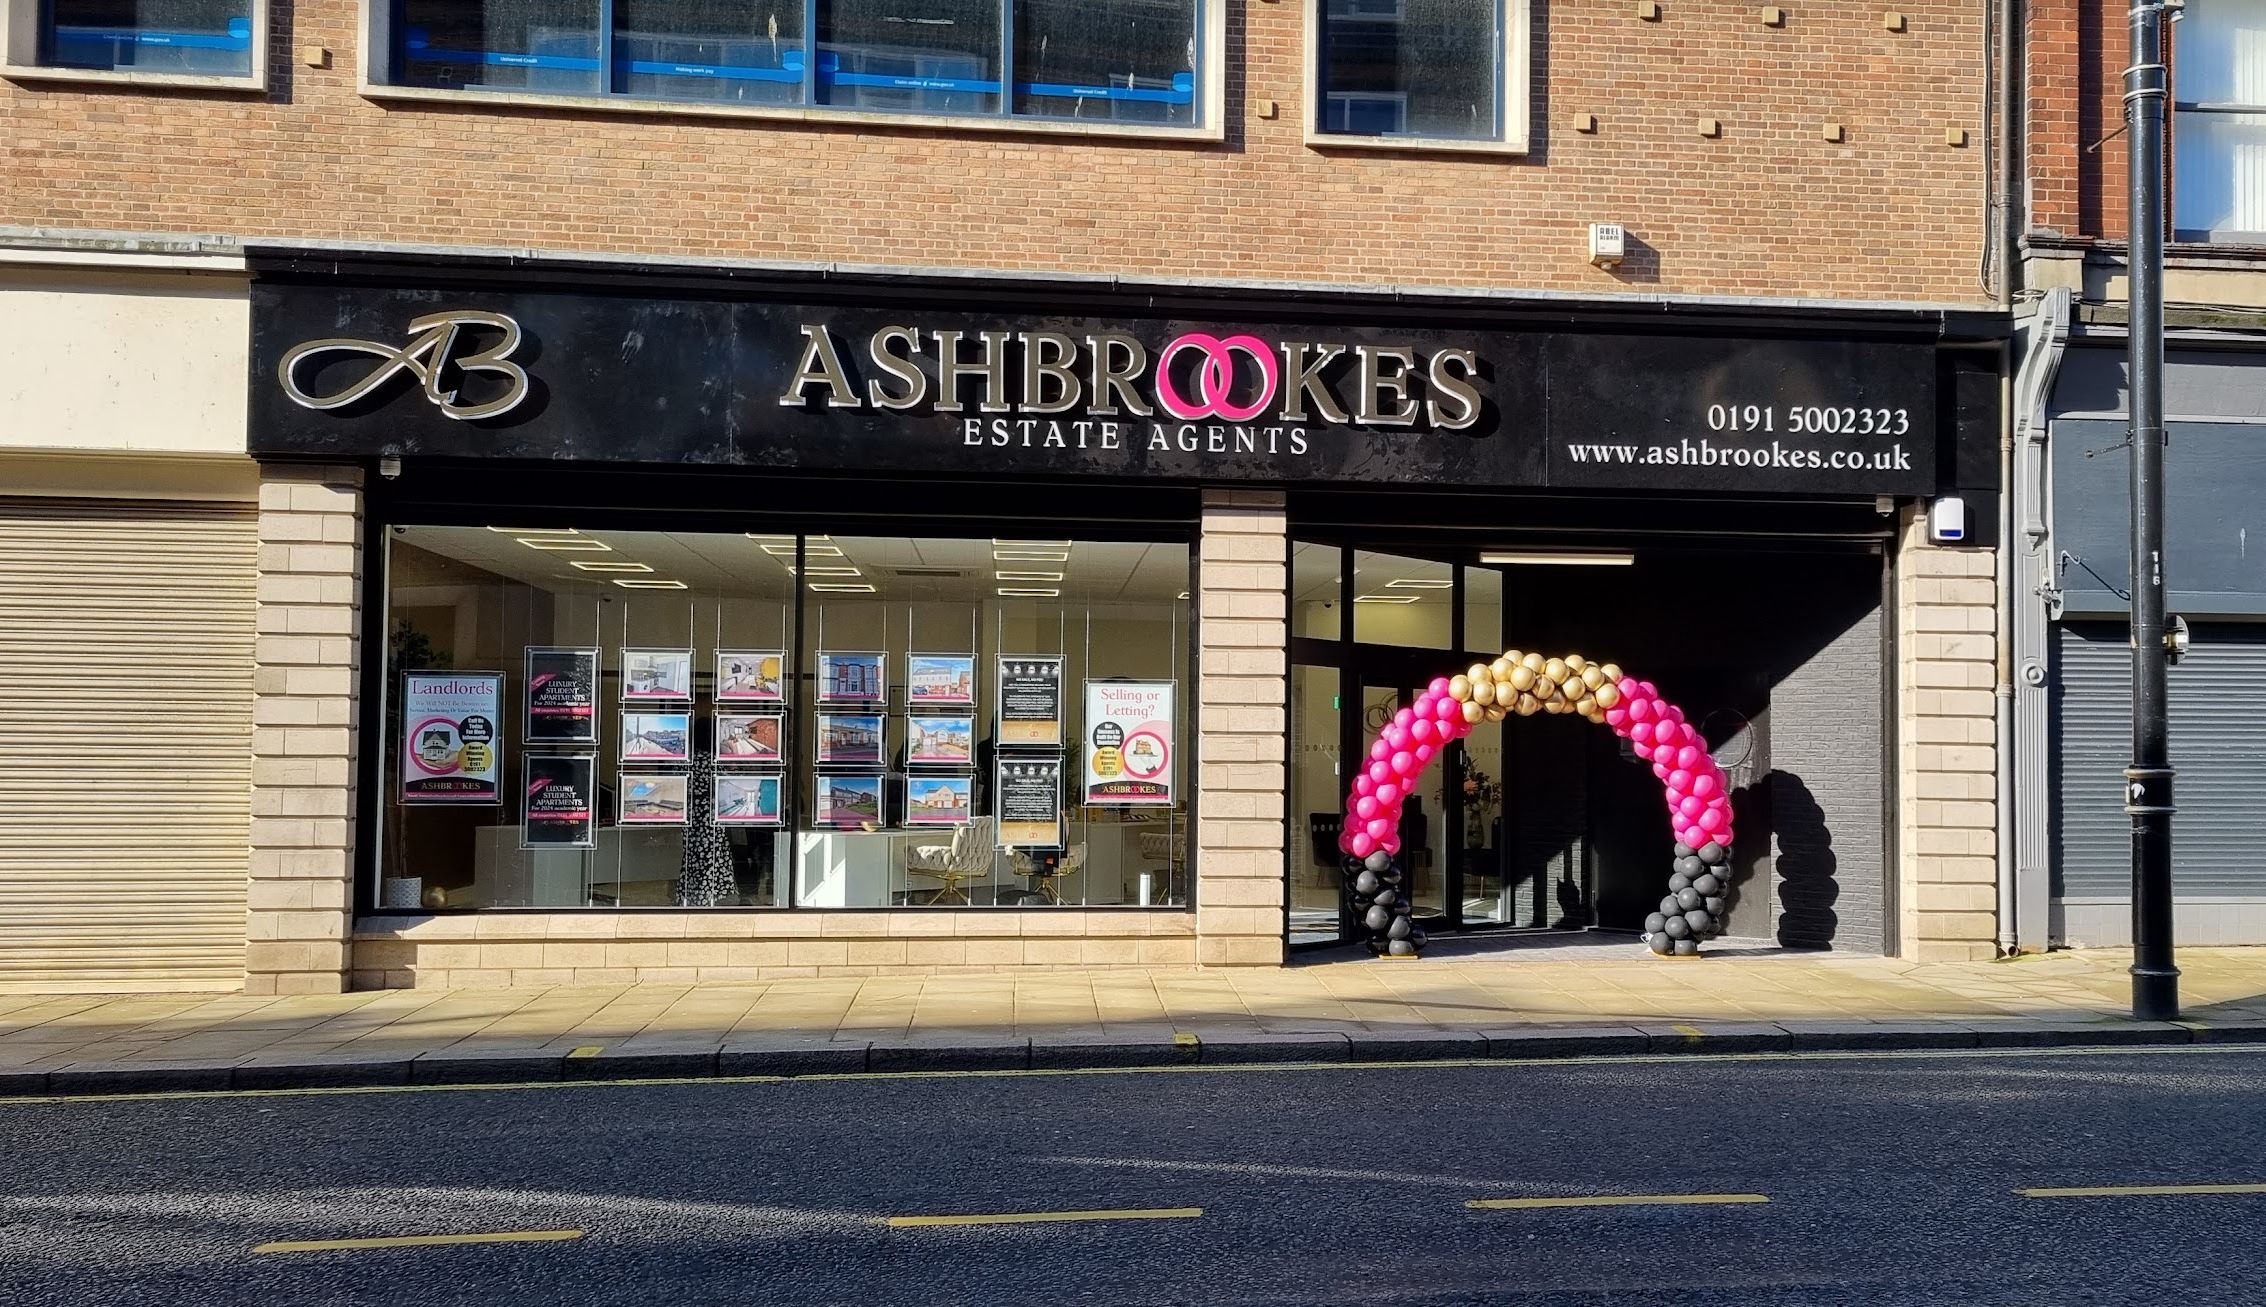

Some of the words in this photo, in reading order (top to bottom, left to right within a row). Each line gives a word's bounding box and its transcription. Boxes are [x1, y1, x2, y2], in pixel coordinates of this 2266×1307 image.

[1599, 227, 1619, 235] ABEL
[780, 323, 1482, 429] ASHBROOKES
[1707, 404, 1774, 431] 0191
[1788, 406, 1910, 435] 5002323
[963, 418, 1120, 449] ESTATE
[1147, 424, 1309, 455] AGENTS
[1567, 438, 1912, 470] www.ashbrookes.co.uk
[412, 680, 493, 695] Landlords
[1101, 688, 1142, 704] Selling
[1146, 692, 1160, 700] or
[1105, 703, 1155, 719] Letting?
[1102, 785, 1157, 794] ASHBROOKES
[536, 798, 583, 806] APARTMENTS
